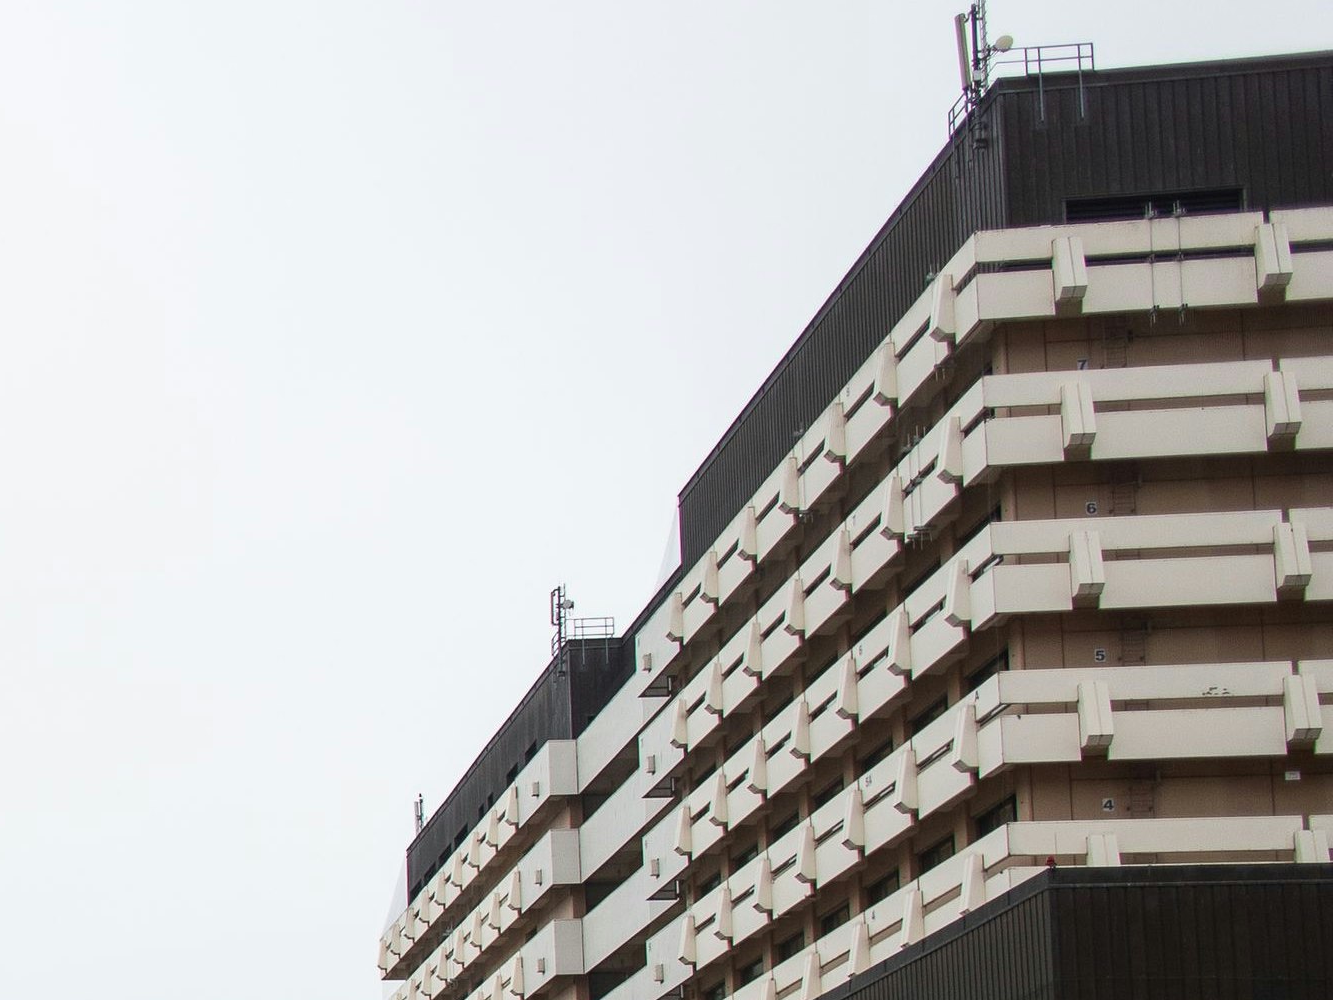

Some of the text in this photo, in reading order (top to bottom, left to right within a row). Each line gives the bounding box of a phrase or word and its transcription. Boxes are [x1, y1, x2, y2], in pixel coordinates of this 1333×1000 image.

[1078, 359, 1087, 370] 7
[1086, 502, 1097, 514] 6
[1095, 650, 1106, 662] 5
[1103, 799, 1114, 810] 4
